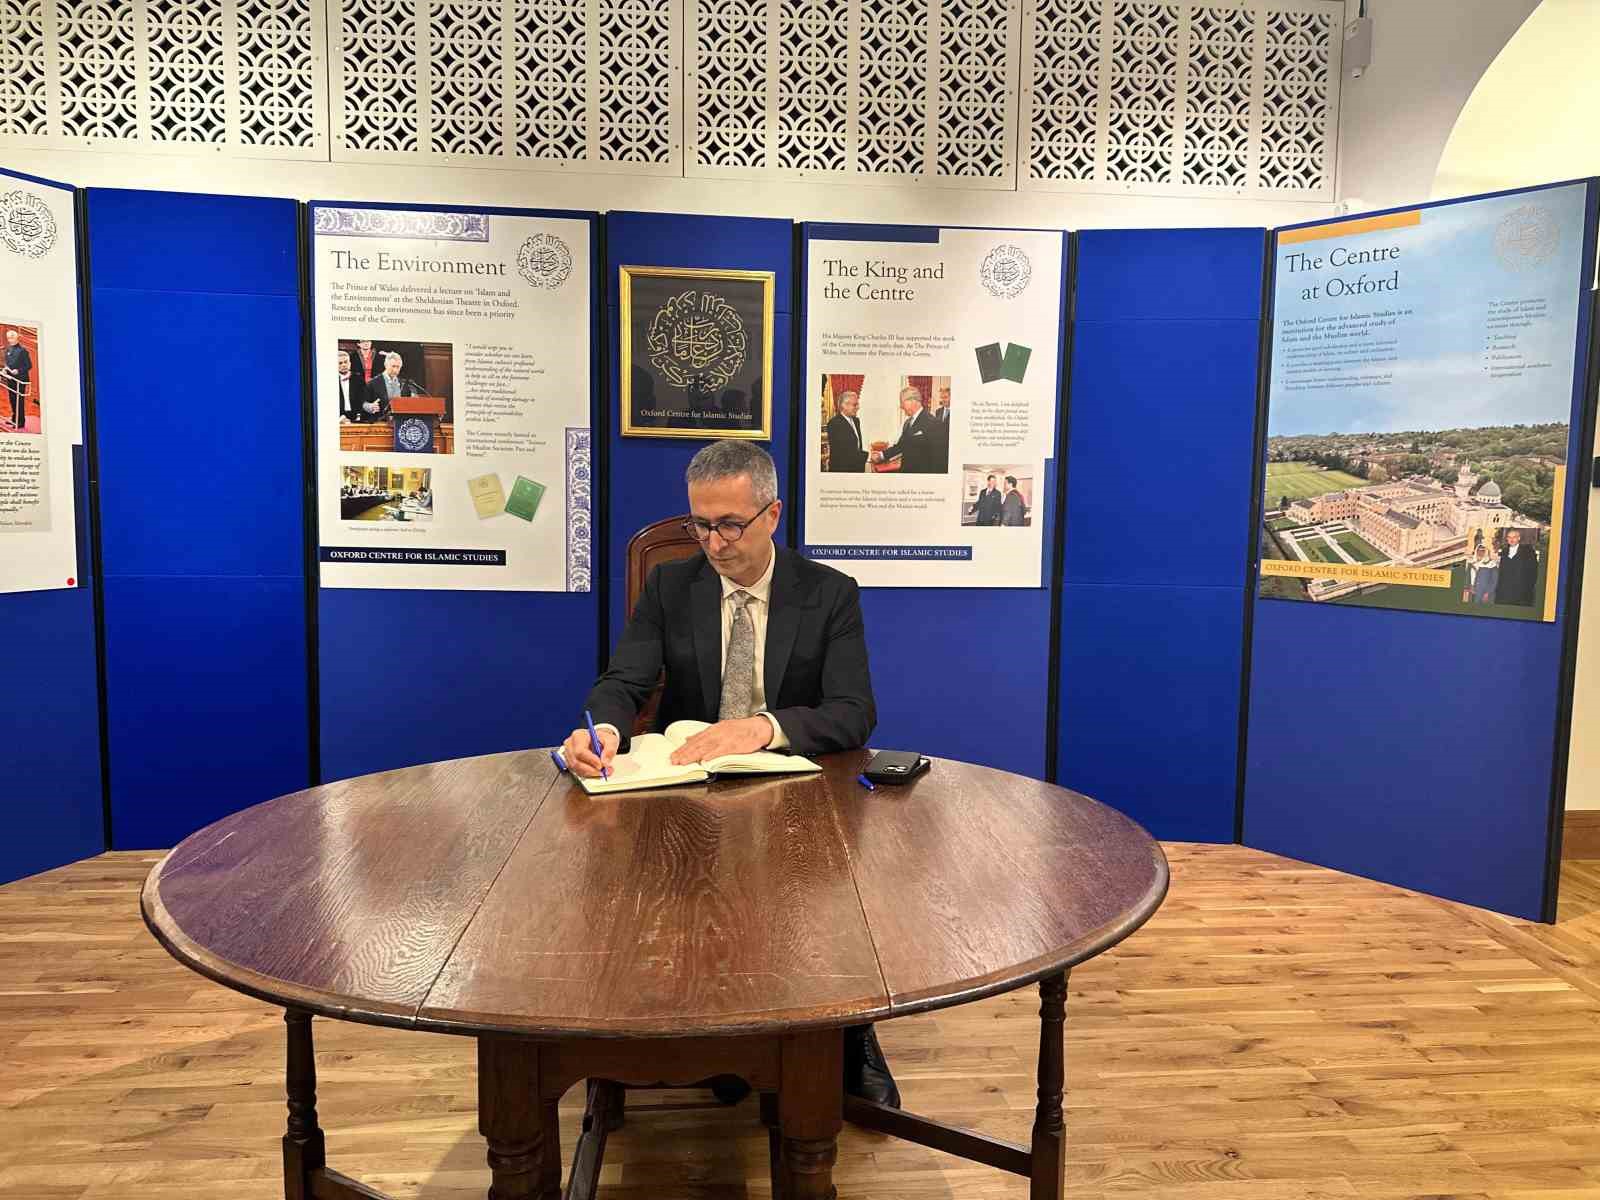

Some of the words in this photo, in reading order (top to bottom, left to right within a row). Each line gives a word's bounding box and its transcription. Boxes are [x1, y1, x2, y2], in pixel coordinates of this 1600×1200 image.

[330, 250, 370, 270] The
[378, 252, 507, 275] Environment
[1285, 252, 1323, 273] The
[1330, 246, 1400, 267] Centre
[823, 259, 858, 277] The
[865, 259, 908, 284] King
[913, 262, 945, 279] and
[330, 281, 345, 290] The
[346, 282, 368, 291] Prince
[379, 284, 399, 292] Wales
[400, 284, 432, 293] delivered
[439, 286, 462, 295] lecture
[498, 289, 511, 297] and
[824, 282, 851, 299] the
[857, 282, 915, 301] Centre
[1302, 286, 1320, 301] at
[1326, 270, 1399, 297] Oxford
[456, 297, 481, 306] Theatre
[331, 314, 357, 322] interest
[368, 314, 379, 323] the
[332, 304, 362, 312] Research
[374, 304, 386, 313] the
[433, 307, 445, 315] has
[465, 309, 482, 317] been
[489, 310, 515, 320] priority
[639, 408, 666, 418] Oxford
[667, 409, 690, 419] Centre
[691, 409, 702, 419] for
[703, 410, 727, 420] Islamic
[728, 411, 753, 421] Studies
[330, 550, 367, 560] OXFORD
[368, 551, 404, 560] CENTRE
[405, 552, 422, 561] FOR
[424, 552, 461, 562] ISLAMIC
[462, 553, 500, 562] STUDIES
[812, 548, 847, 557] OXFORD
[848, 548, 881, 557] CENTRE
[882, 549, 899, 557] FOR
[900, 549, 933, 558] ISLAMIC
[934, 549, 969, 558] STUDIES
[1264, 562, 1301, 575] OXFORD
[1302, 564, 1338, 577] CENTRE
[1340, 566, 1359, 577] FOR
[1361, 567, 1402, 581] ISLAMIC
[1403, 571, 1446, 584] STUDIES
